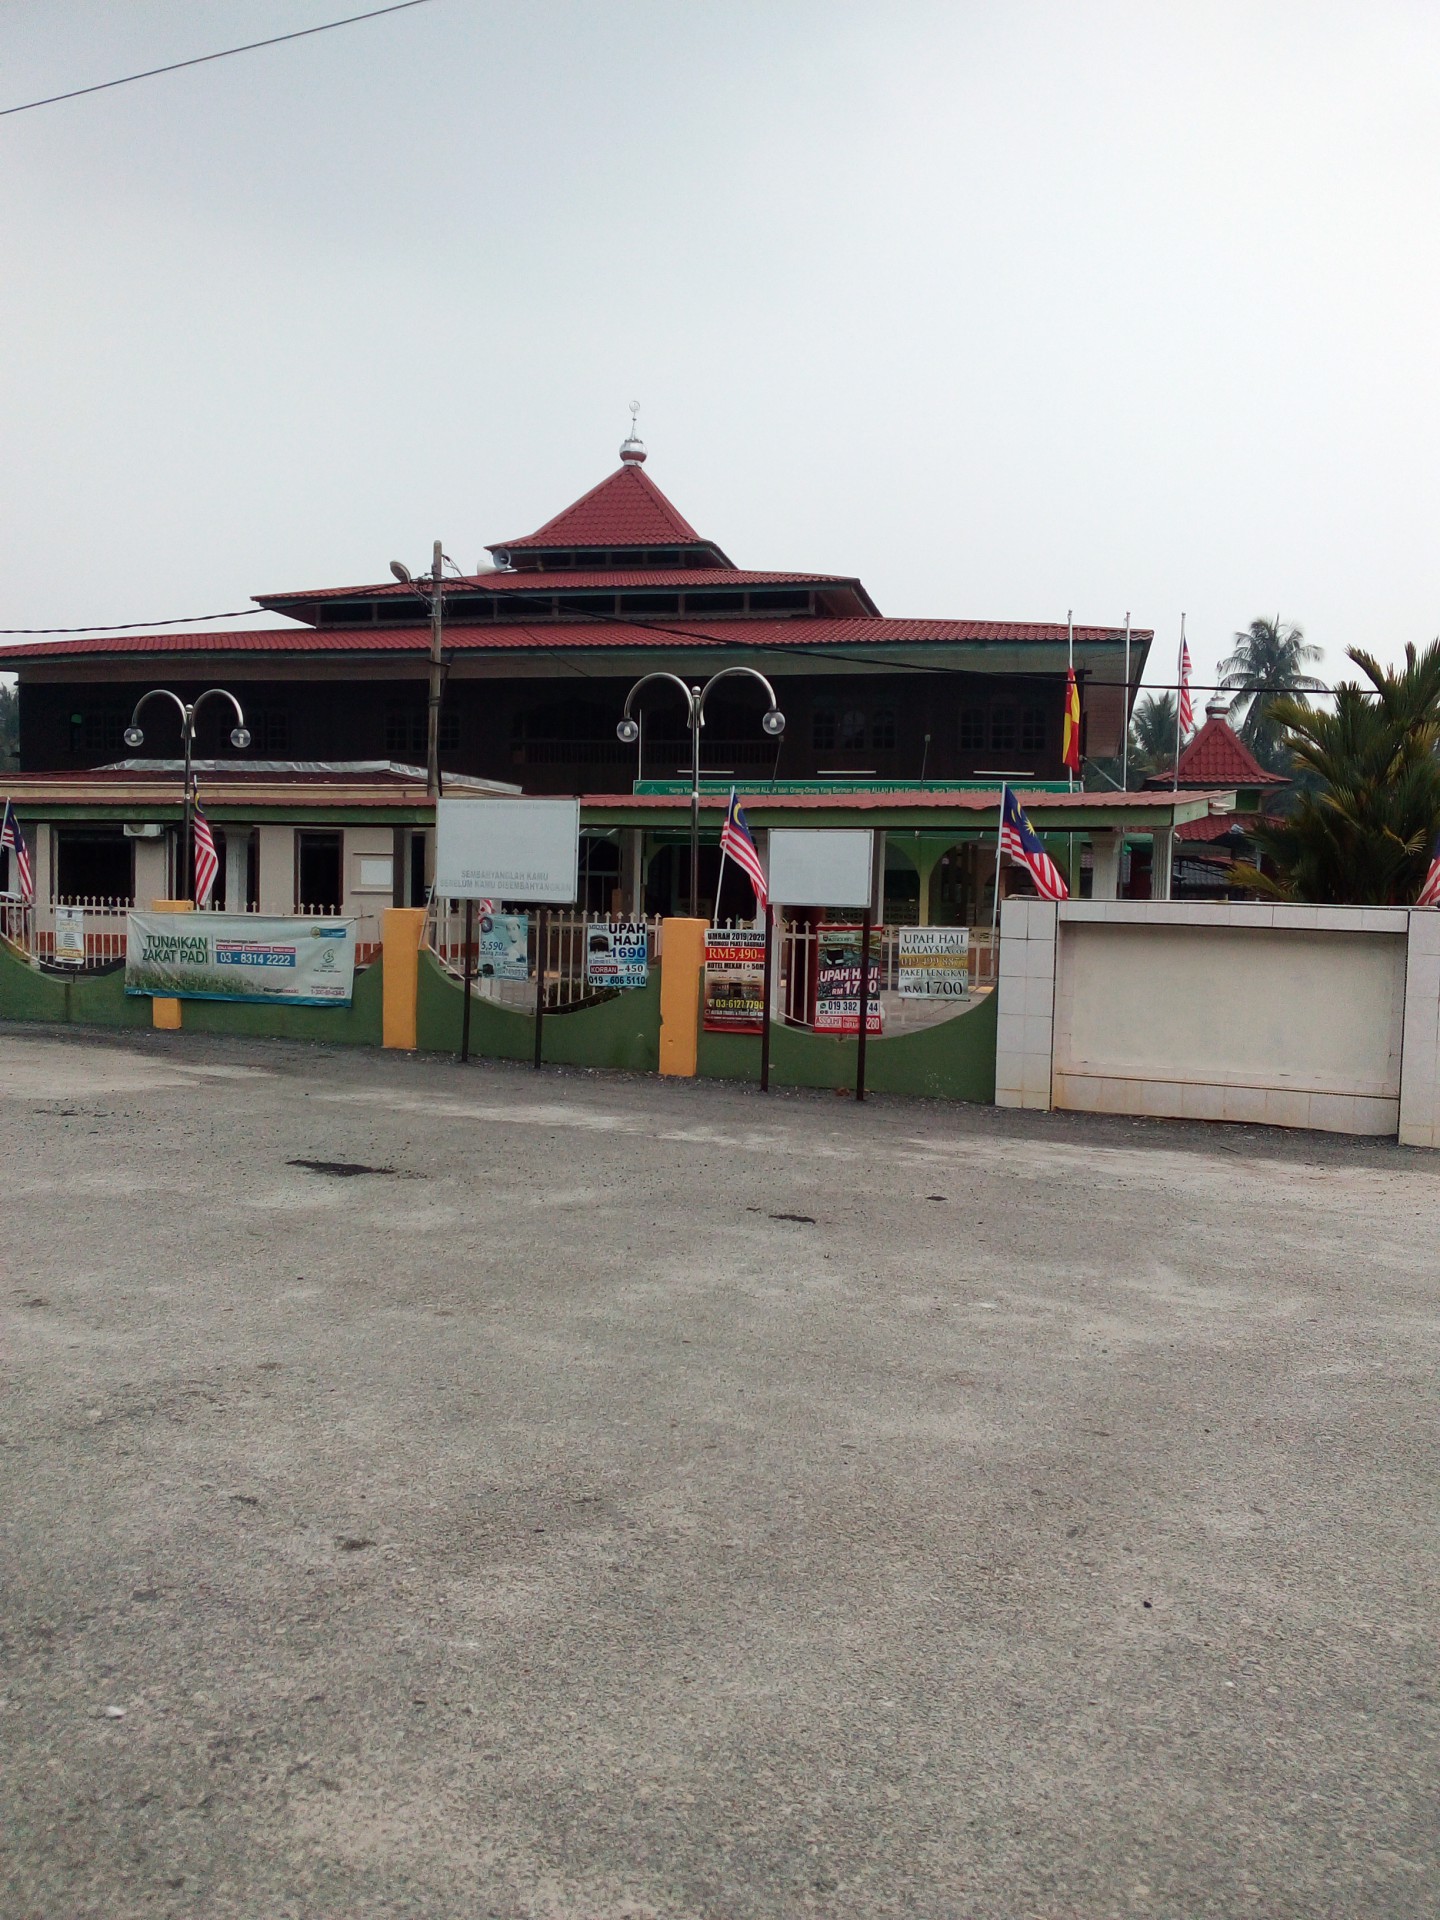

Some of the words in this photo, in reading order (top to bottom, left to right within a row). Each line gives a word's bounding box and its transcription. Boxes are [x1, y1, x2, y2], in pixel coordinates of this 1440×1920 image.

[526, 871, 549, 881] KAMU
[474, 880, 496, 889] KAMU
[608, 923, 646, 934] UPAH
[613, 935, 645, 946] HAJI
[707, 932, 731, 940] UMRAH
[904, 934, 934, 944] UPAH
[939, 934, 964, 945] HAJI
[146, 935, 208, 949] TUNAIKAN
[481, 941, 503, 950] 5,590
[142, 948, 177, 962] ZAKAT
[180, 950, 208, 963] PADI
[611, 947, 646, 958] 1690
[220, 952, 232, 963] 03
[240, 953, 264, 964] 8314
[266, 954, 291, 965] 2222
[901, 957, 918, 966] 019
[724, 962, 742, 970] MEKAH
[820, 968, 849, 982] UPAH
[851, 967, 878, 980] HJI
[900, 969, 924, 977] PAKEJ
[926, 969, 967, 977] LENGKAP
[588, 975, 604, 984] 019
[610, 976, 624, 984] 606
[626, 976, 646, 985] 5110
[746, 1000, 765, 1010] 7790
[828, 1001, 840, 1010] 019
[843, 1001, 858, 1011] 382
